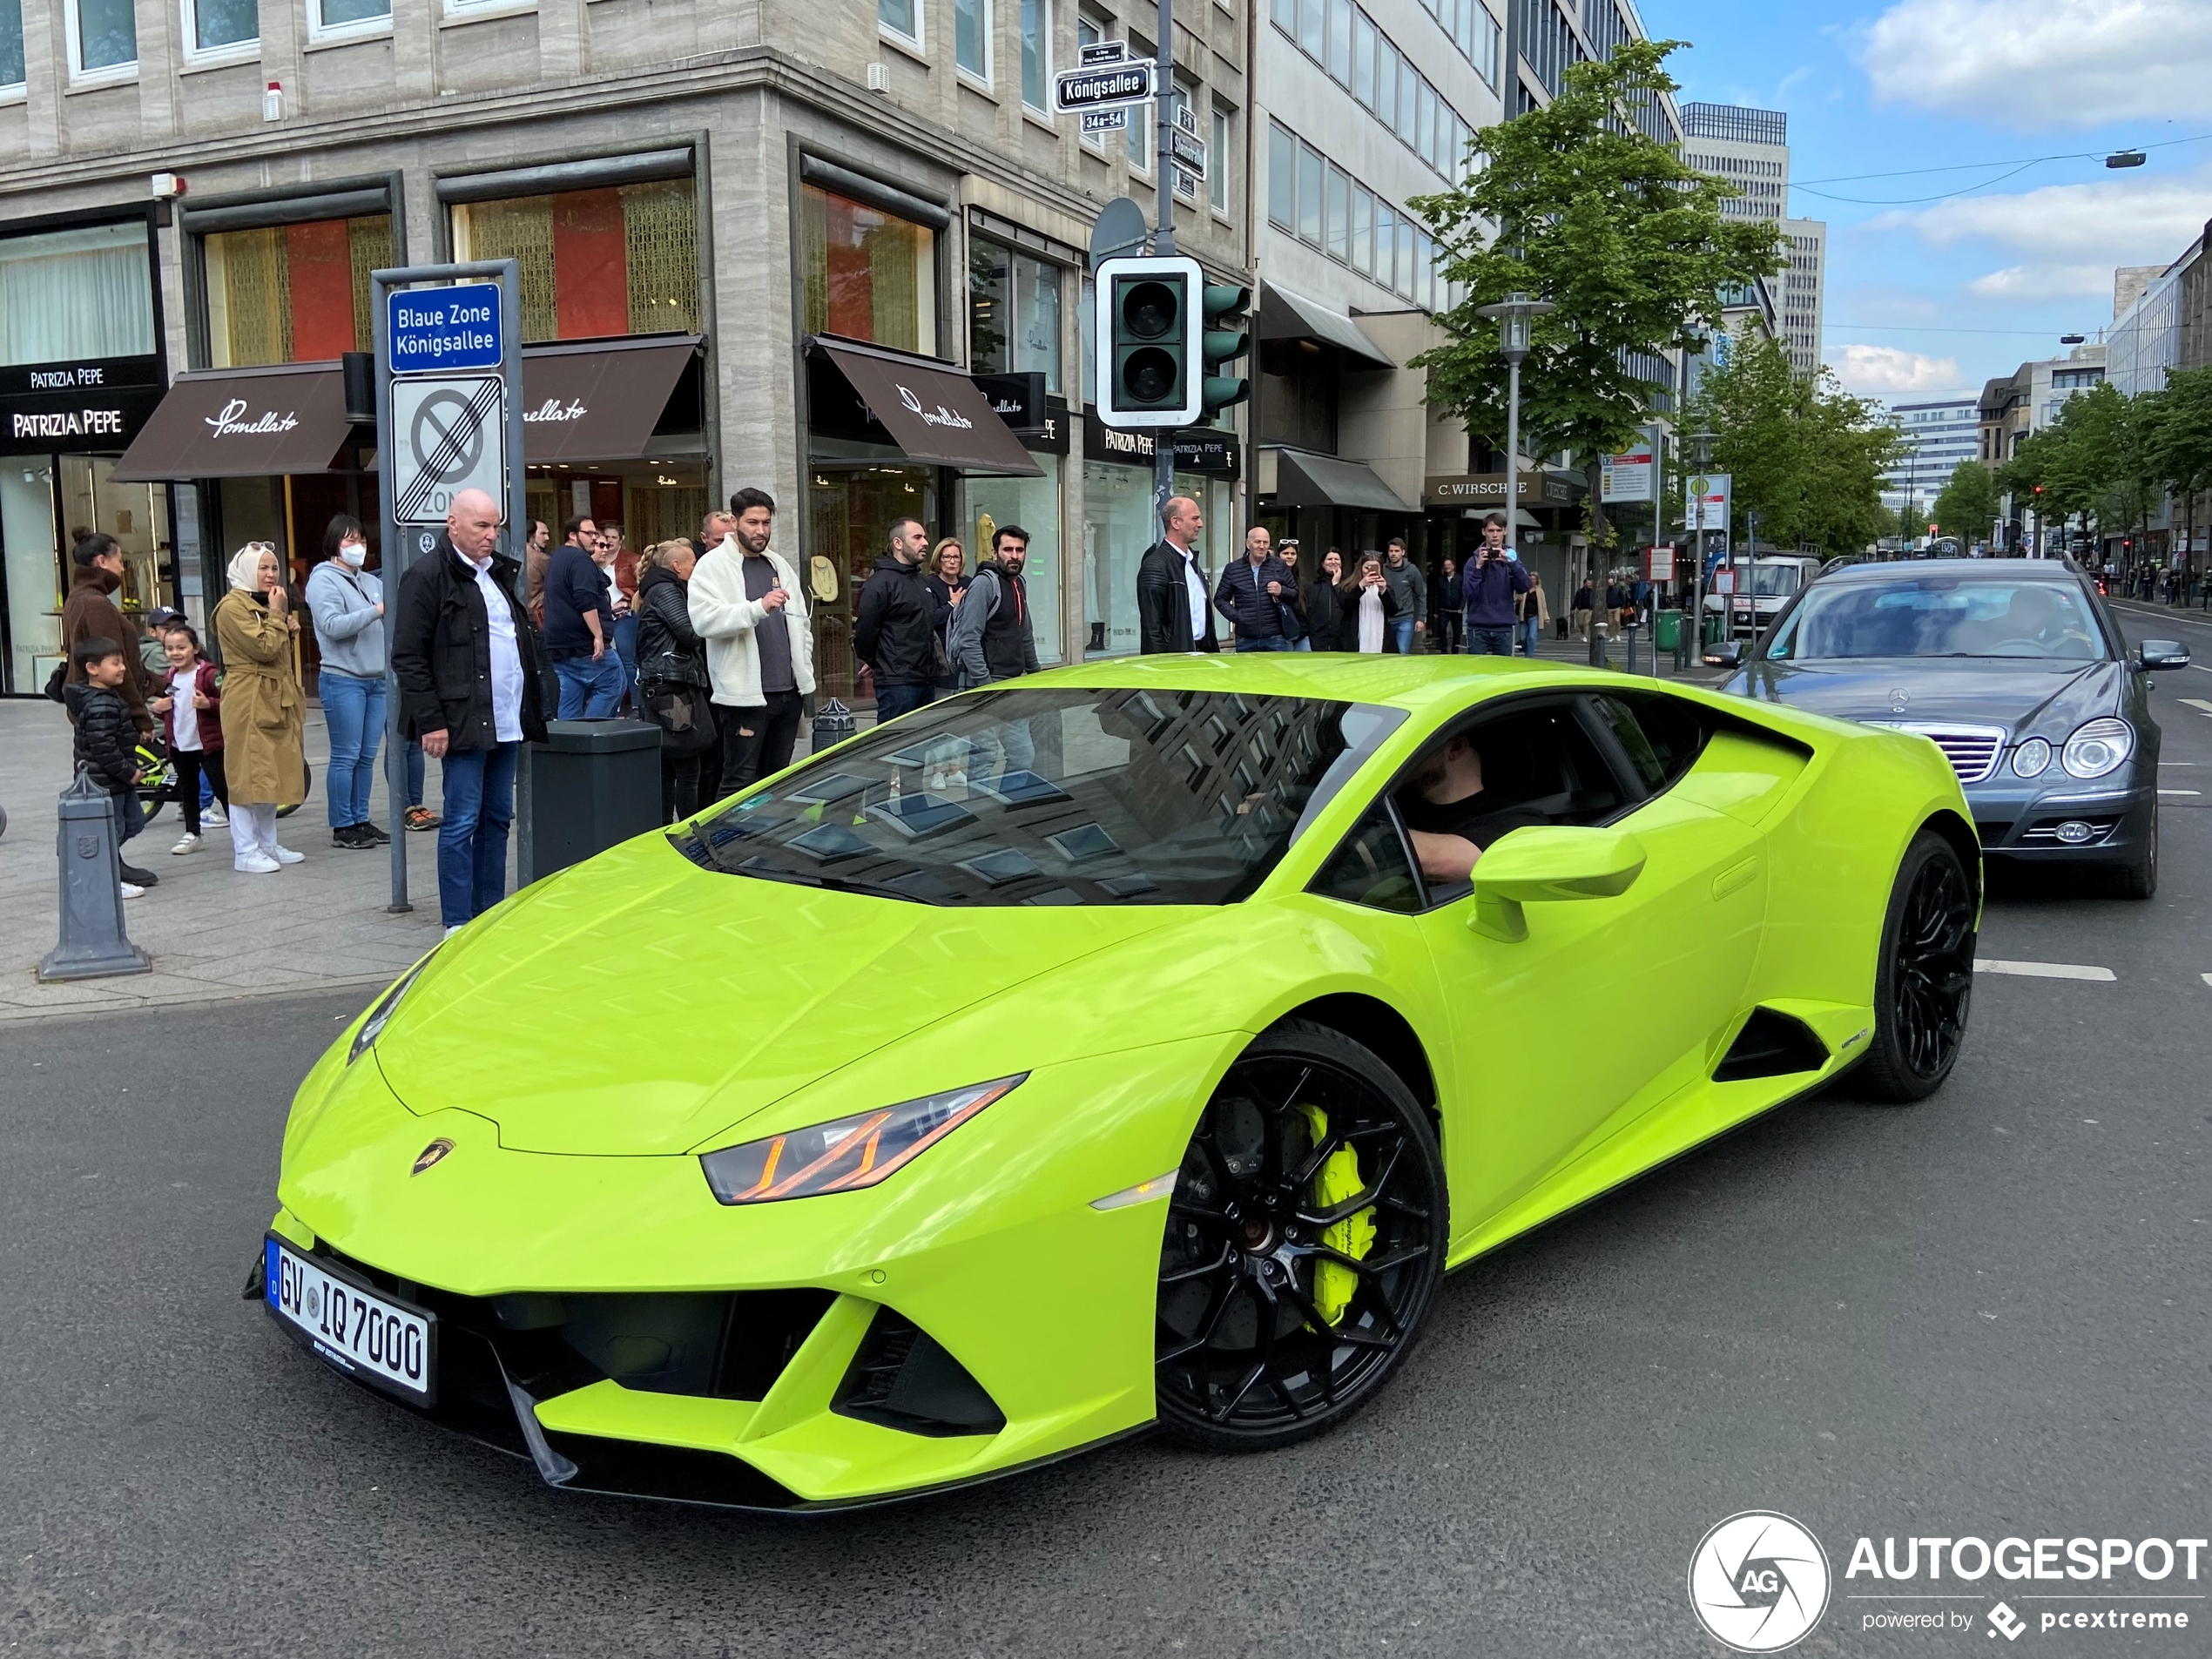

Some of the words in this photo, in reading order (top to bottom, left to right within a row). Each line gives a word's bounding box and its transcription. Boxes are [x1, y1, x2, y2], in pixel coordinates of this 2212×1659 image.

[1066, 74, 1139, 100] Königsallee
[1086, 112, 1122, 128] 34a-54
[398, 307, 444, 329] Blaue
[449, 304, 490, 325] Zone
[396, 330, 494, 357] Königsallee
[30, 371, 75, 388] PATRIZIA
[78, 368, 104, 385] PEPE
[895, 383, 973, 429] Pomellato
[981, 392, 1022, 413] ellato
[13, 413, 80, 438] PATRIZIA
[84, 409, 122, 435] PEPE
[205, 398, 300, 439] Pomellato
[1105, 428, 1136, 453] PATRIZIA
[1137, 434, 1154, 455] PEPE
[1204, 443, 1223, 453] PEPE
[1438, 482, 1527, 495] C.WIRSCHE
[422, 491, 461, 513] ZO
[272, 1280, 277, 1295] D
[281, 1255, 304, 1316] GV
[320, 1280, 347, 1345] IQ
[354, 1297, 421, 1380] 7000
